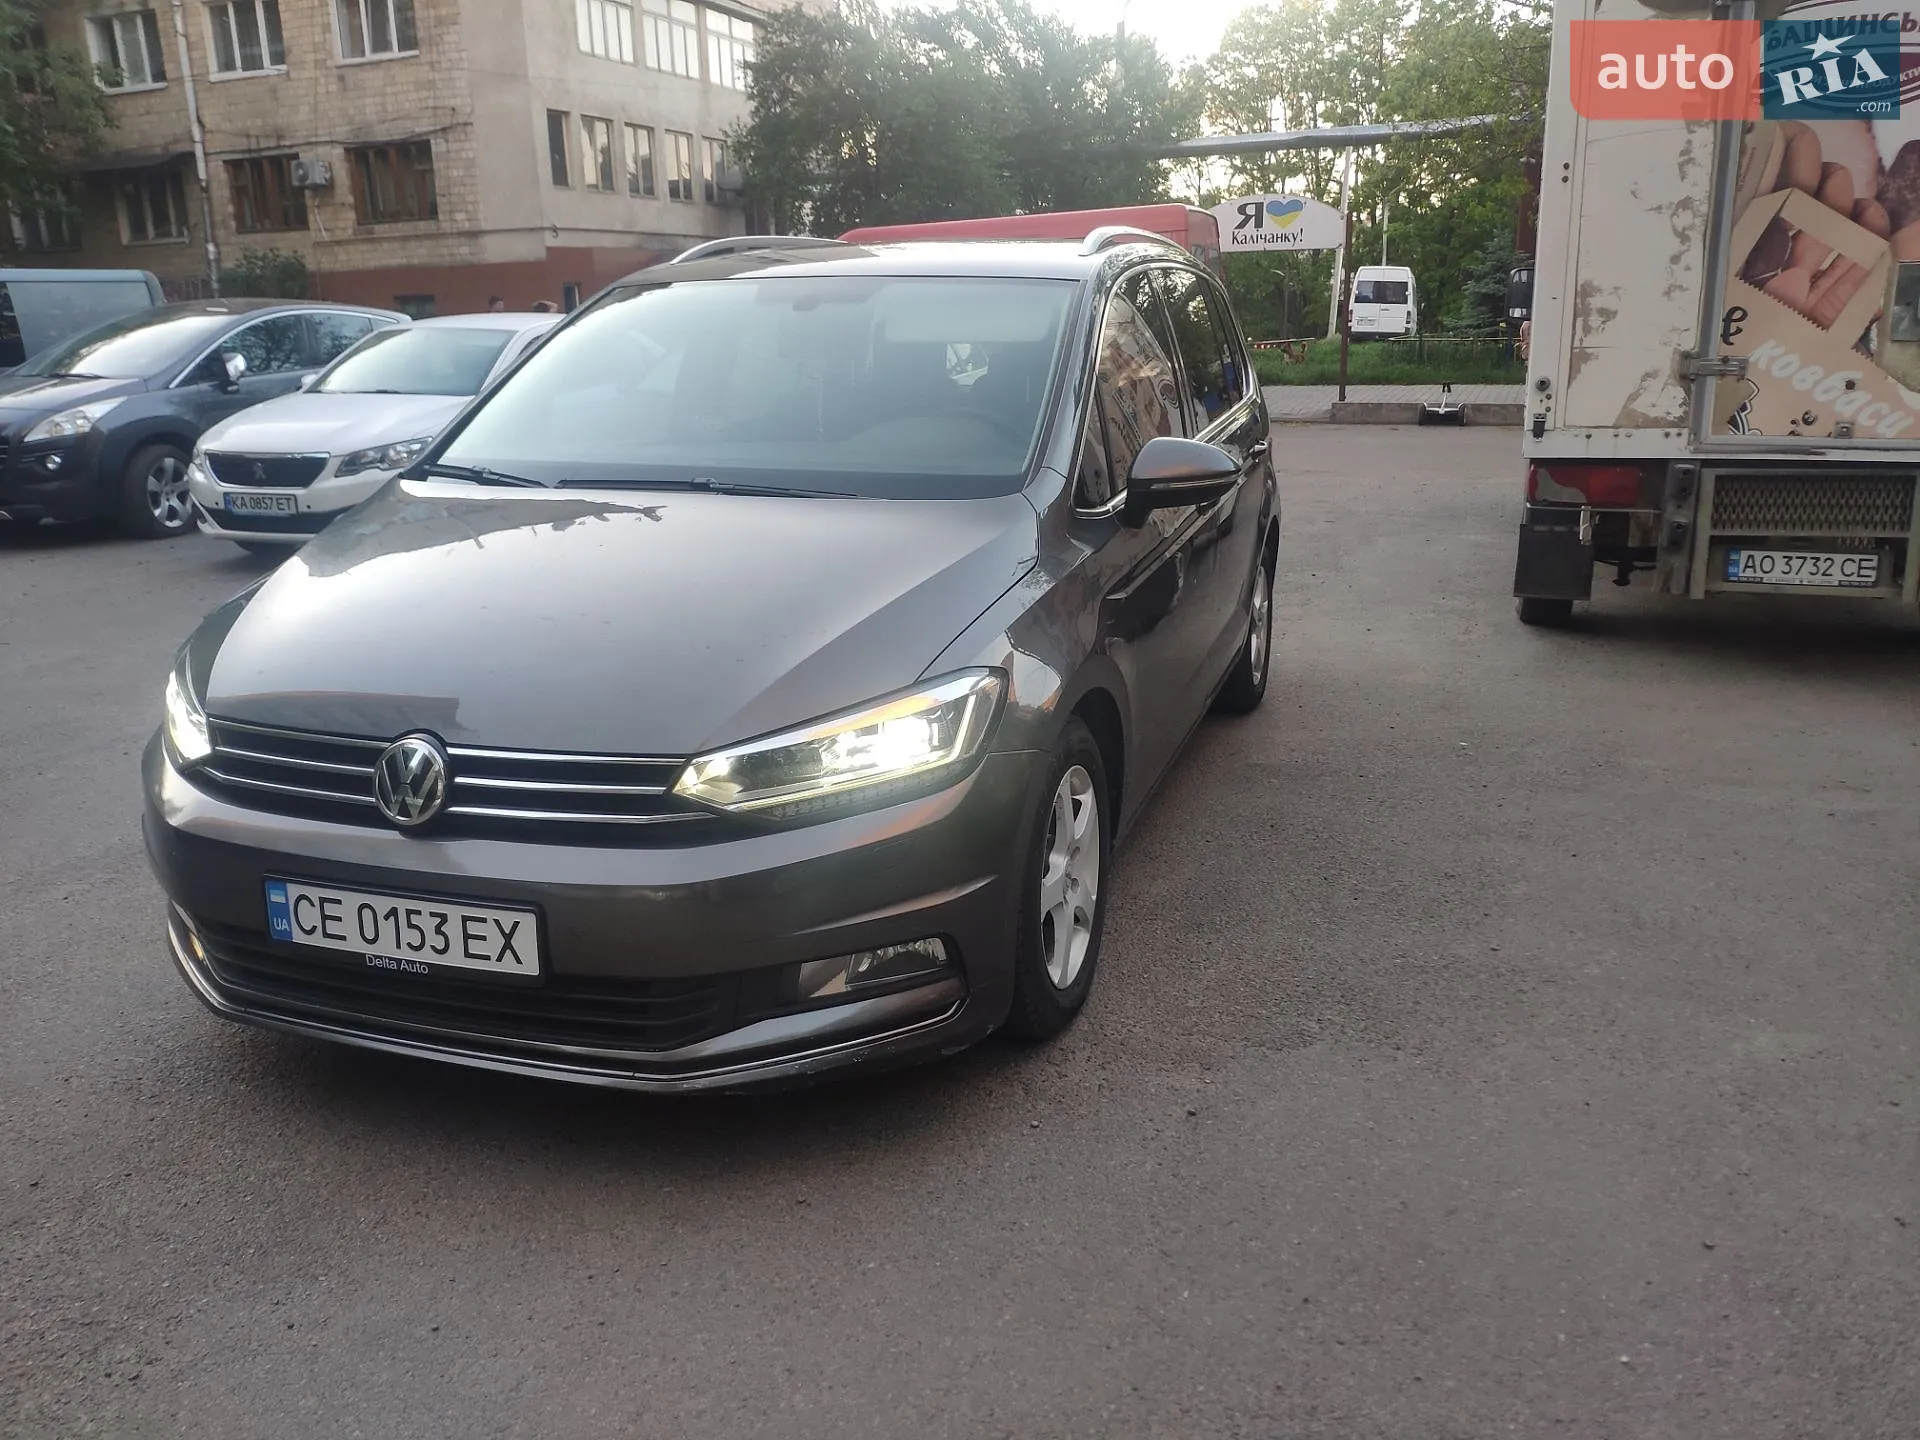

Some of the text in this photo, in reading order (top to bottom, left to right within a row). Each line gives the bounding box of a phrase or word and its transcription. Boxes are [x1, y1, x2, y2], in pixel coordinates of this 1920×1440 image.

[1235, 202, 1264, 230] Я
[1232, 228, 1304, 247] Калічанку!
[231, 496, 292, 511] KA 0857 ET
[1742, 554, 1876, 578] AO 3732 CE
[273, 918, 290, 931] UA
[293, 893, 524, 965] CE 0153 EX
[366, 954, 429, 975] Delta Auto
